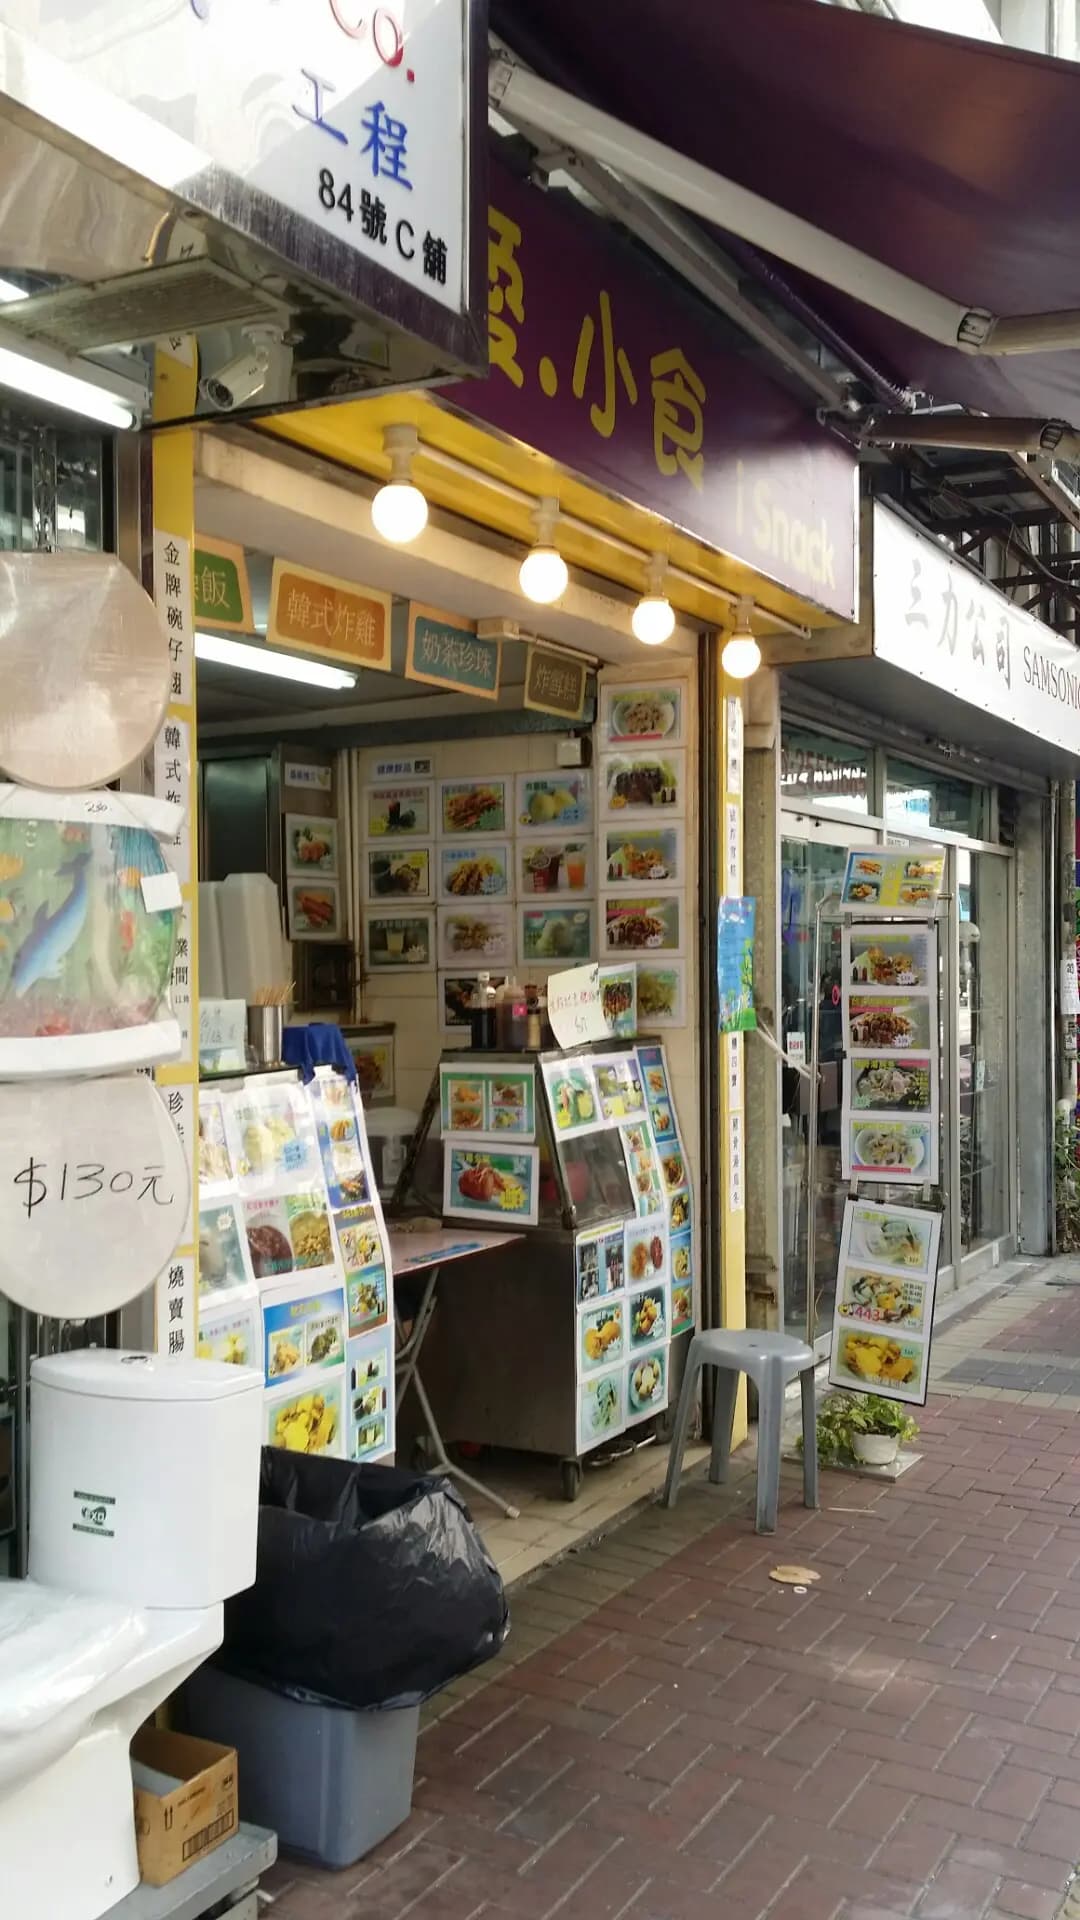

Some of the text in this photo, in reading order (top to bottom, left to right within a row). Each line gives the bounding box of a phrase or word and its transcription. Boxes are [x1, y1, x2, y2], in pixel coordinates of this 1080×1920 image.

[292, 68, 414, 191] 工程
[752, 479, 837, 592] Snack
[195, 565, 231, 609] 飯
[286, 587, 377, 648] 韓式炸雞
[421, 629, 492, 680] 奶茶珍珠
[13, 1157, 175, 1219] $130元
